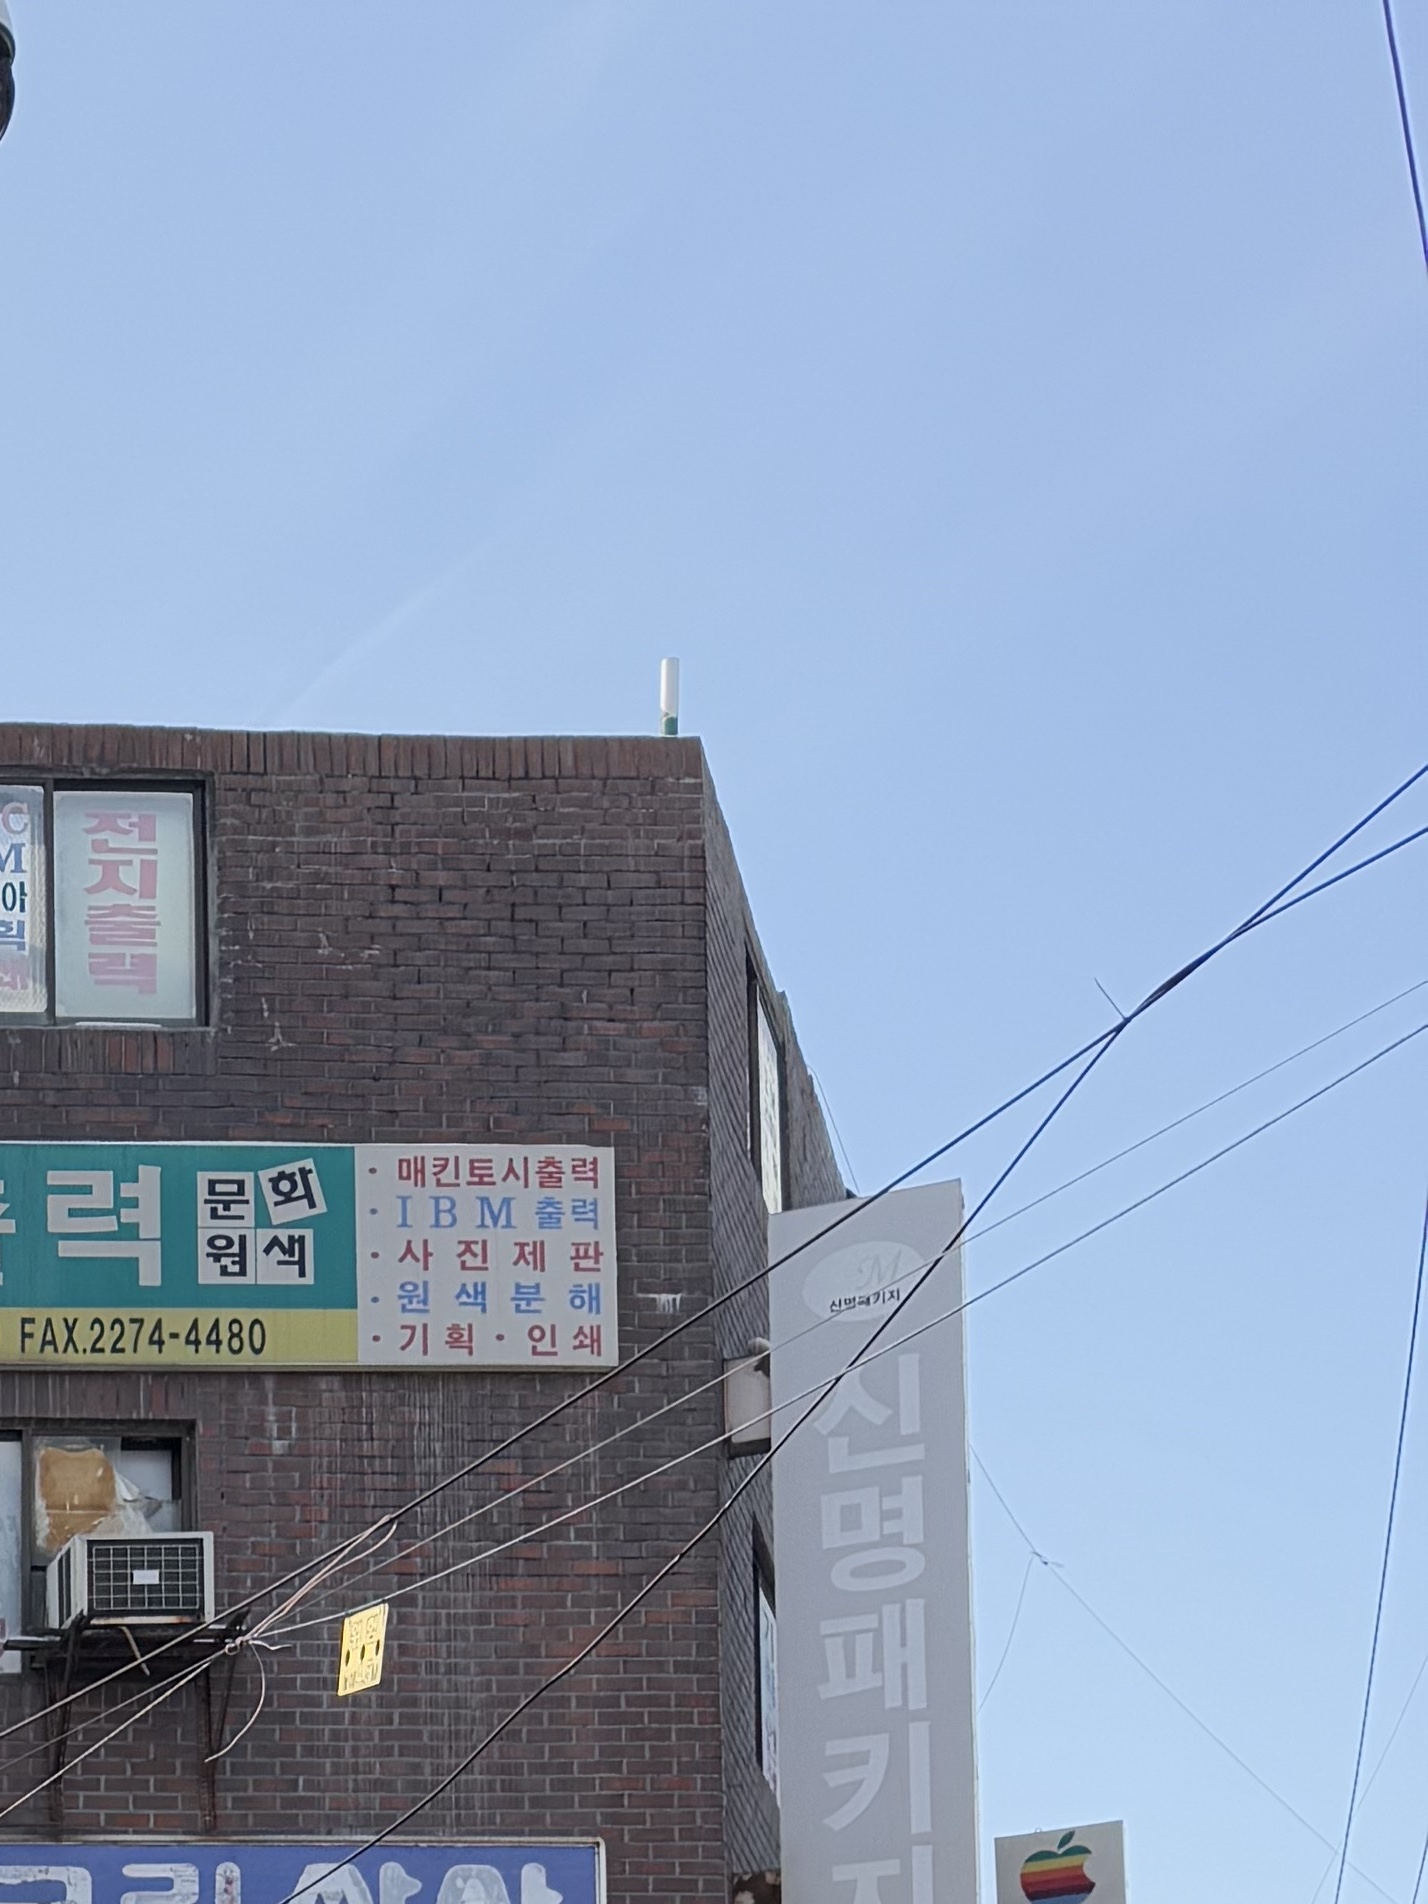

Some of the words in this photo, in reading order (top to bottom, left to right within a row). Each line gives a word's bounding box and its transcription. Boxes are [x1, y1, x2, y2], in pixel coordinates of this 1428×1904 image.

[83, 811, 161, 995] 전지출력
[204, 1165, 318, 1222] 문화
[397, 1155, 600, 1189] 매킨토시출력
[535, 1196, 600, 1231] 출력
[205, 1234, 307, 1280] 원색
[20, 1316, 268, 1356] FAX.2274-4480
